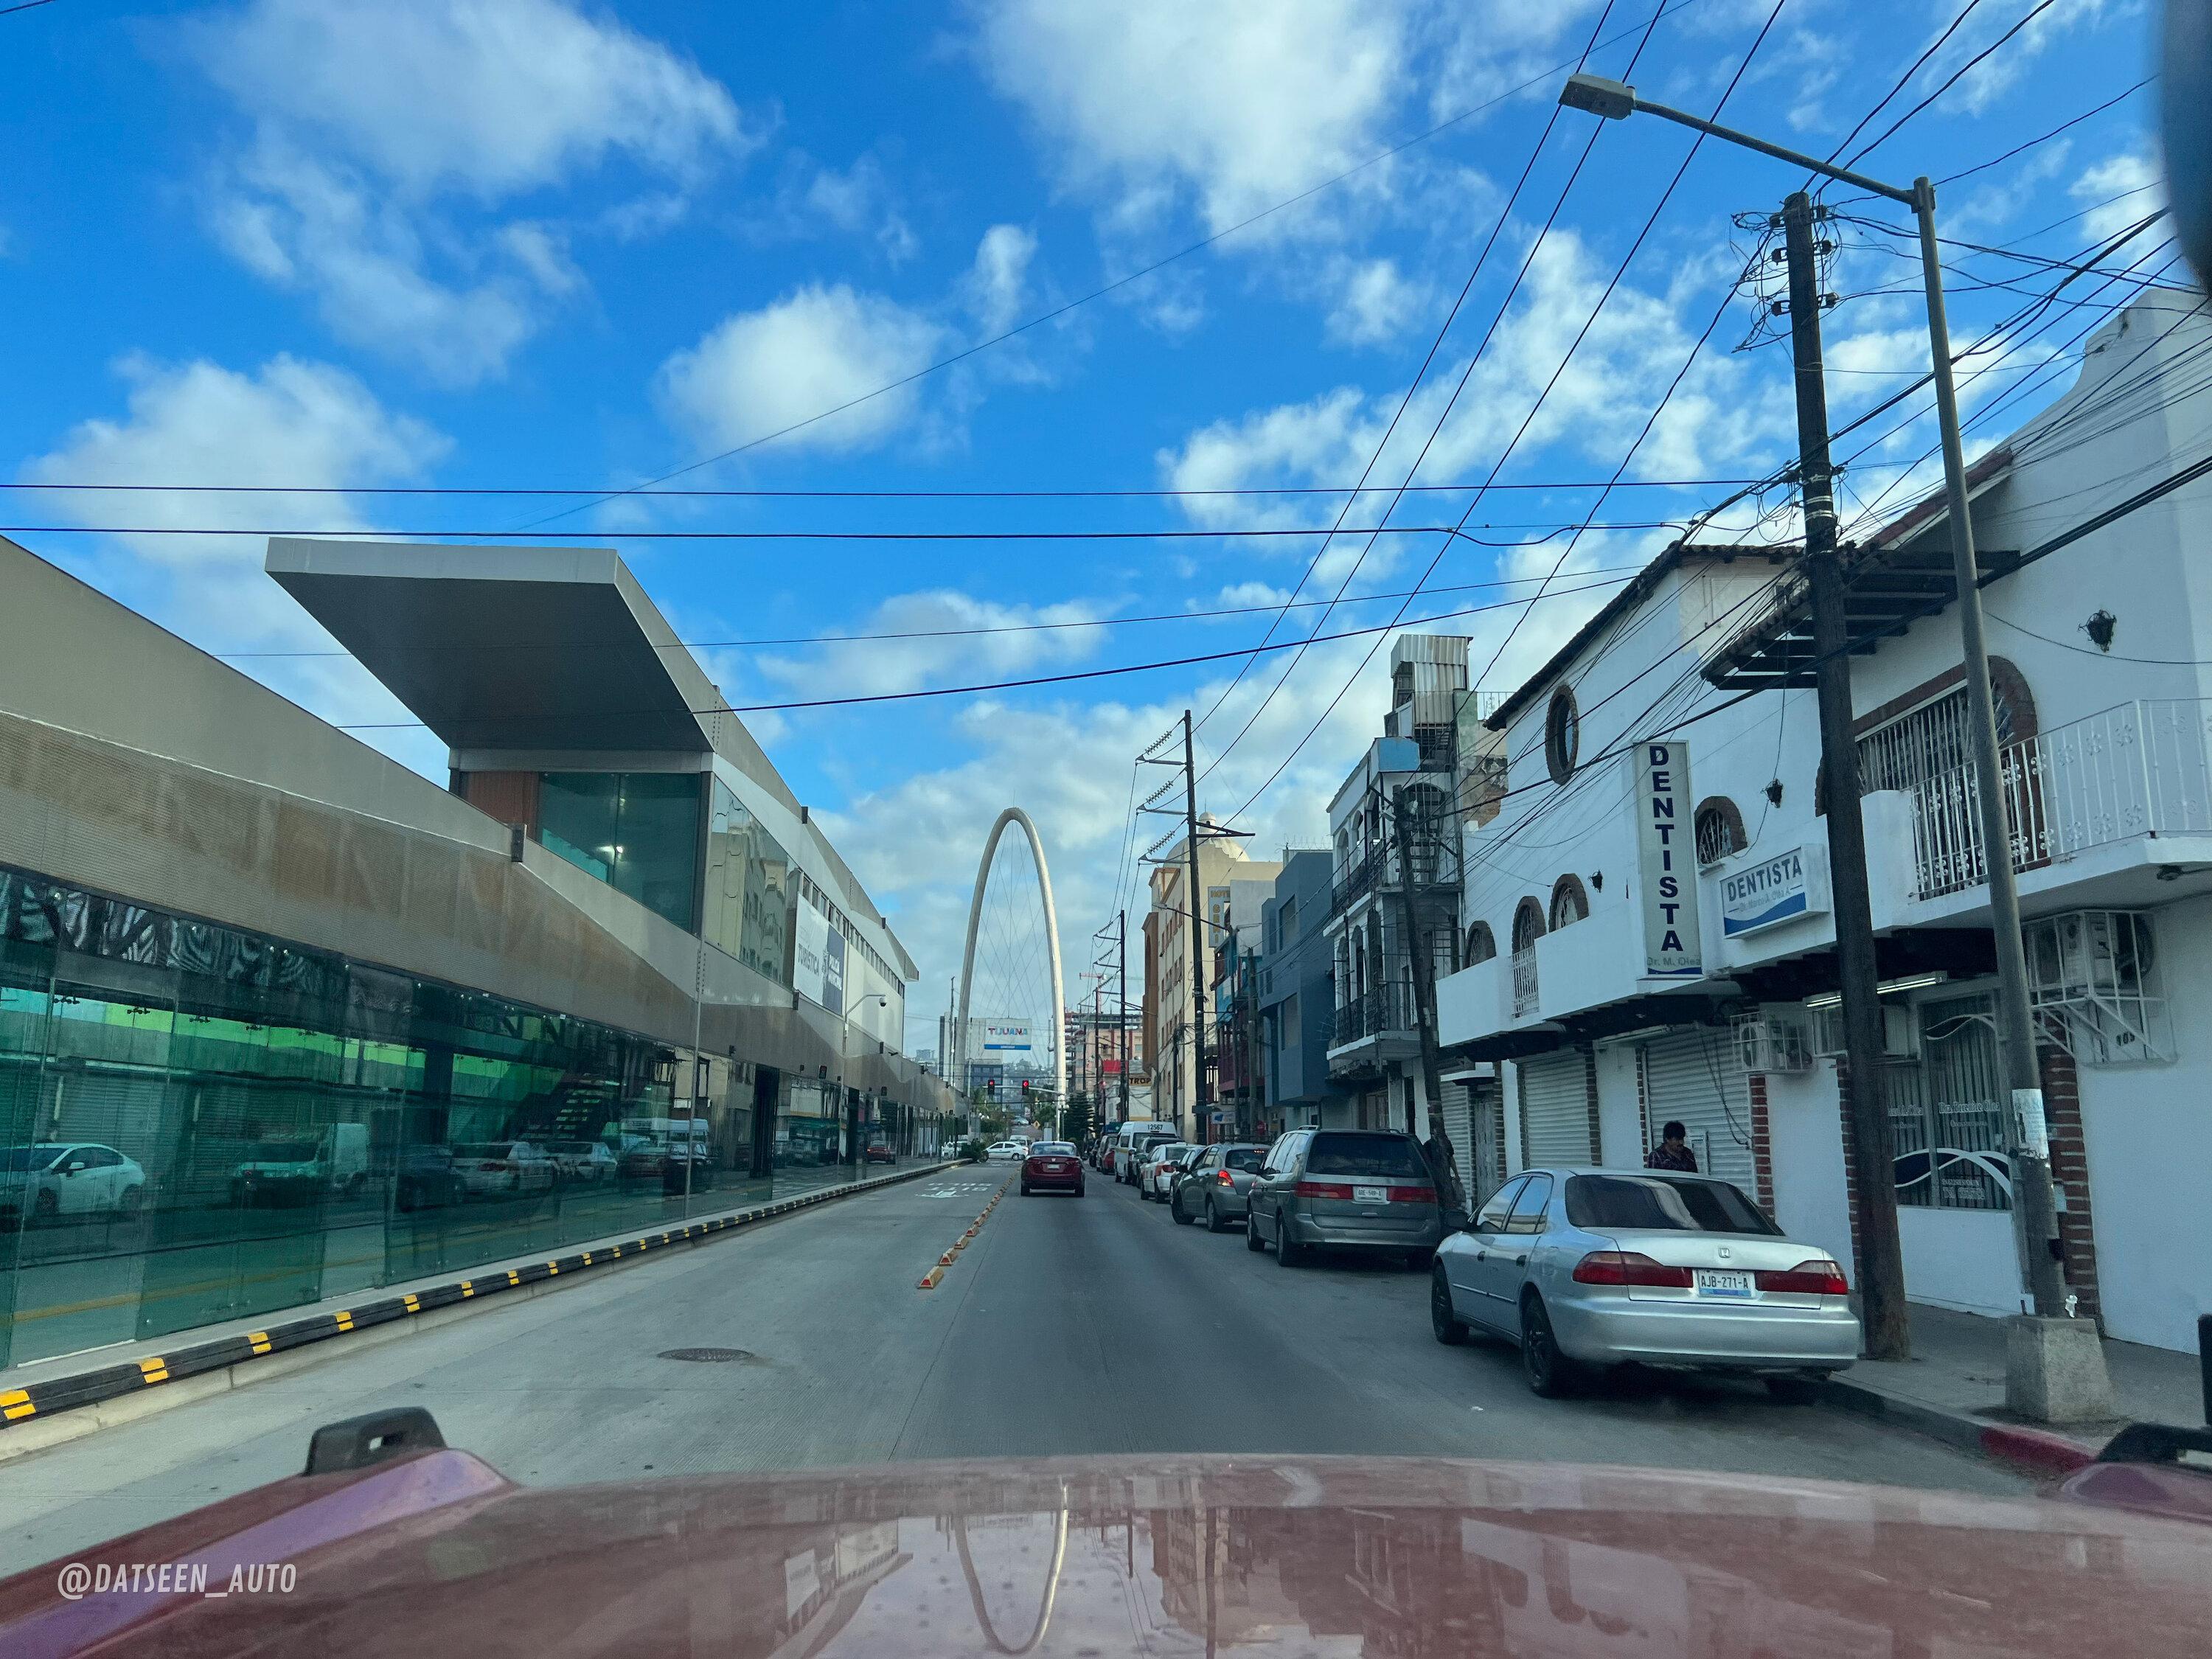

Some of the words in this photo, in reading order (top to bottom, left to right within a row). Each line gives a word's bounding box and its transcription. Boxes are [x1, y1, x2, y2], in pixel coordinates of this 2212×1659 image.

[1649, 745, 1684, 952] DENTISTA
[1728, 855, 1802, 902] DENTISTA
[1646, 957, 1660, 966] Dr.
[1663, 957, 1675, 966] M.
[1677, 956, 1701, 966] Olea
[988, 1026, 1028, 1036] TIJUANA
[1701, 1275, 1748, 1289] AJB-271-A
